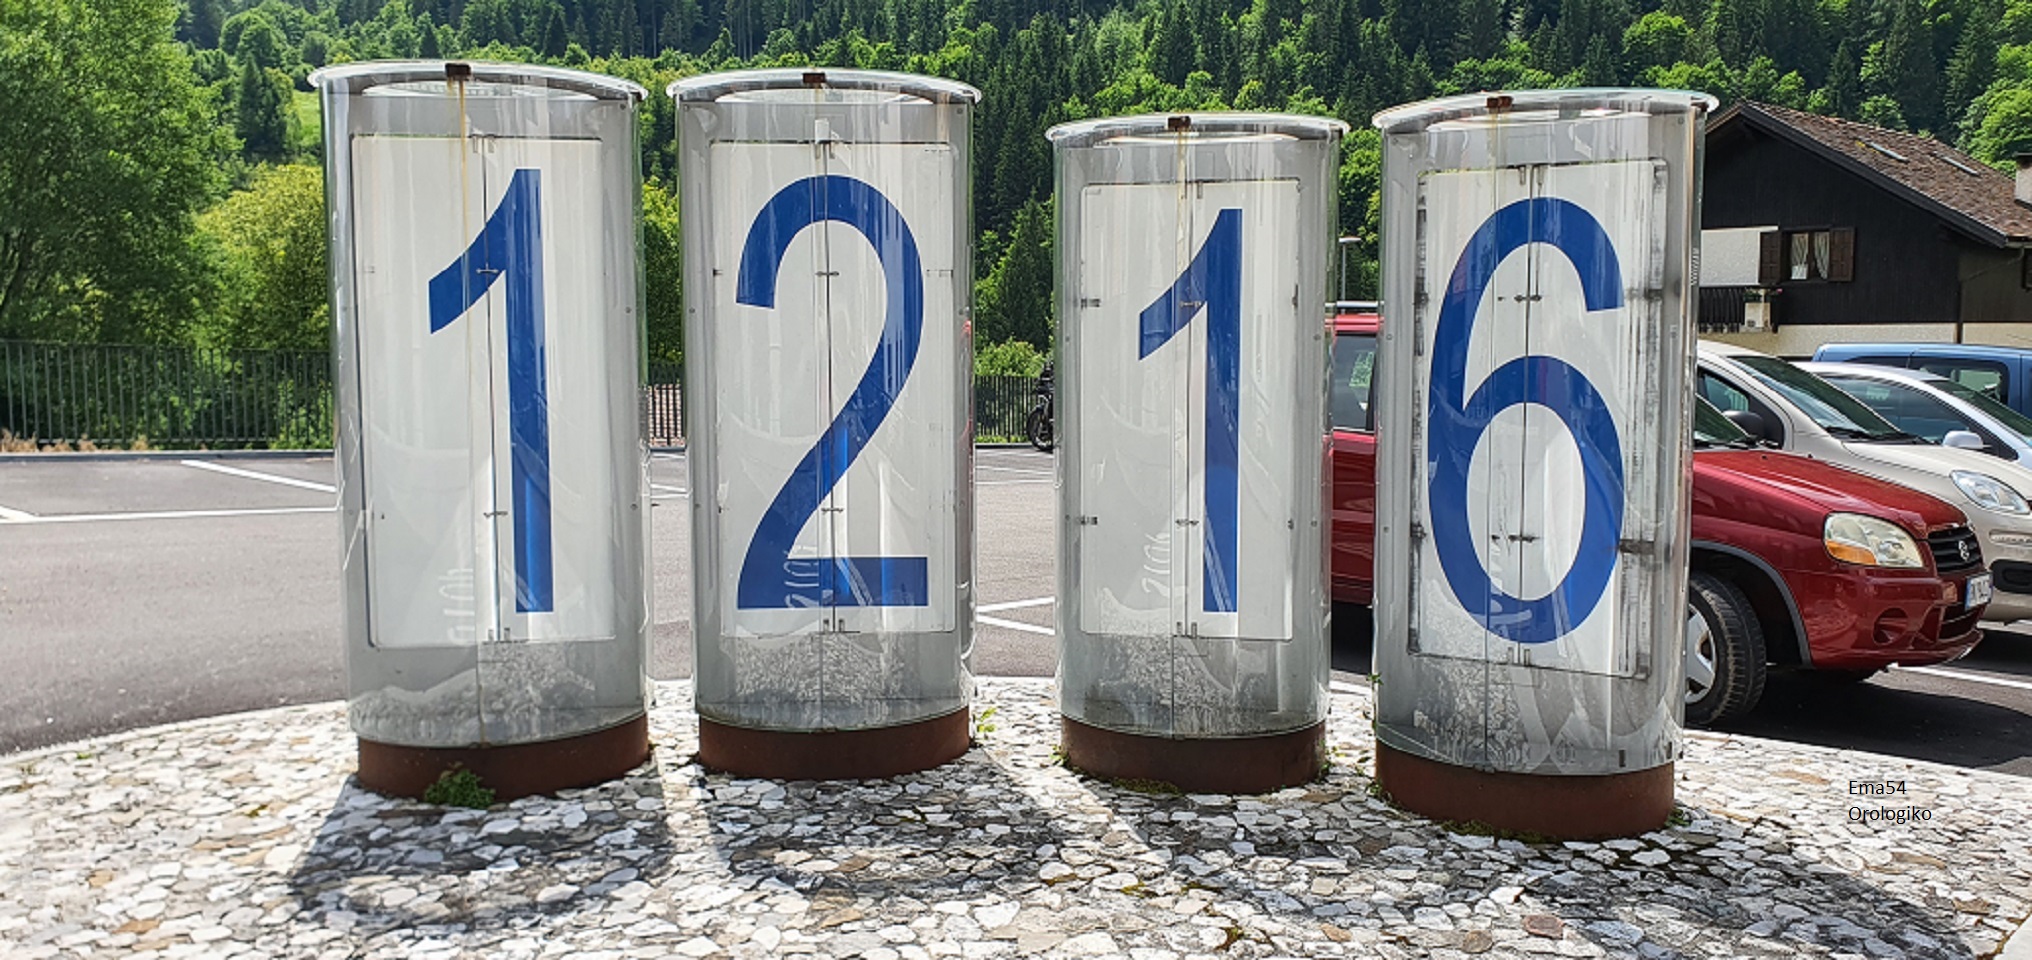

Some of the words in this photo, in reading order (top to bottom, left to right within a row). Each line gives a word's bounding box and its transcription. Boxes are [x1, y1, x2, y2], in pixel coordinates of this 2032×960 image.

[429, 169, 553, 613] 1
[737, 175, 928, 609] 2
[1139, 208, 1243, 613] 1
[1429, 197, 1625, 643] 6
